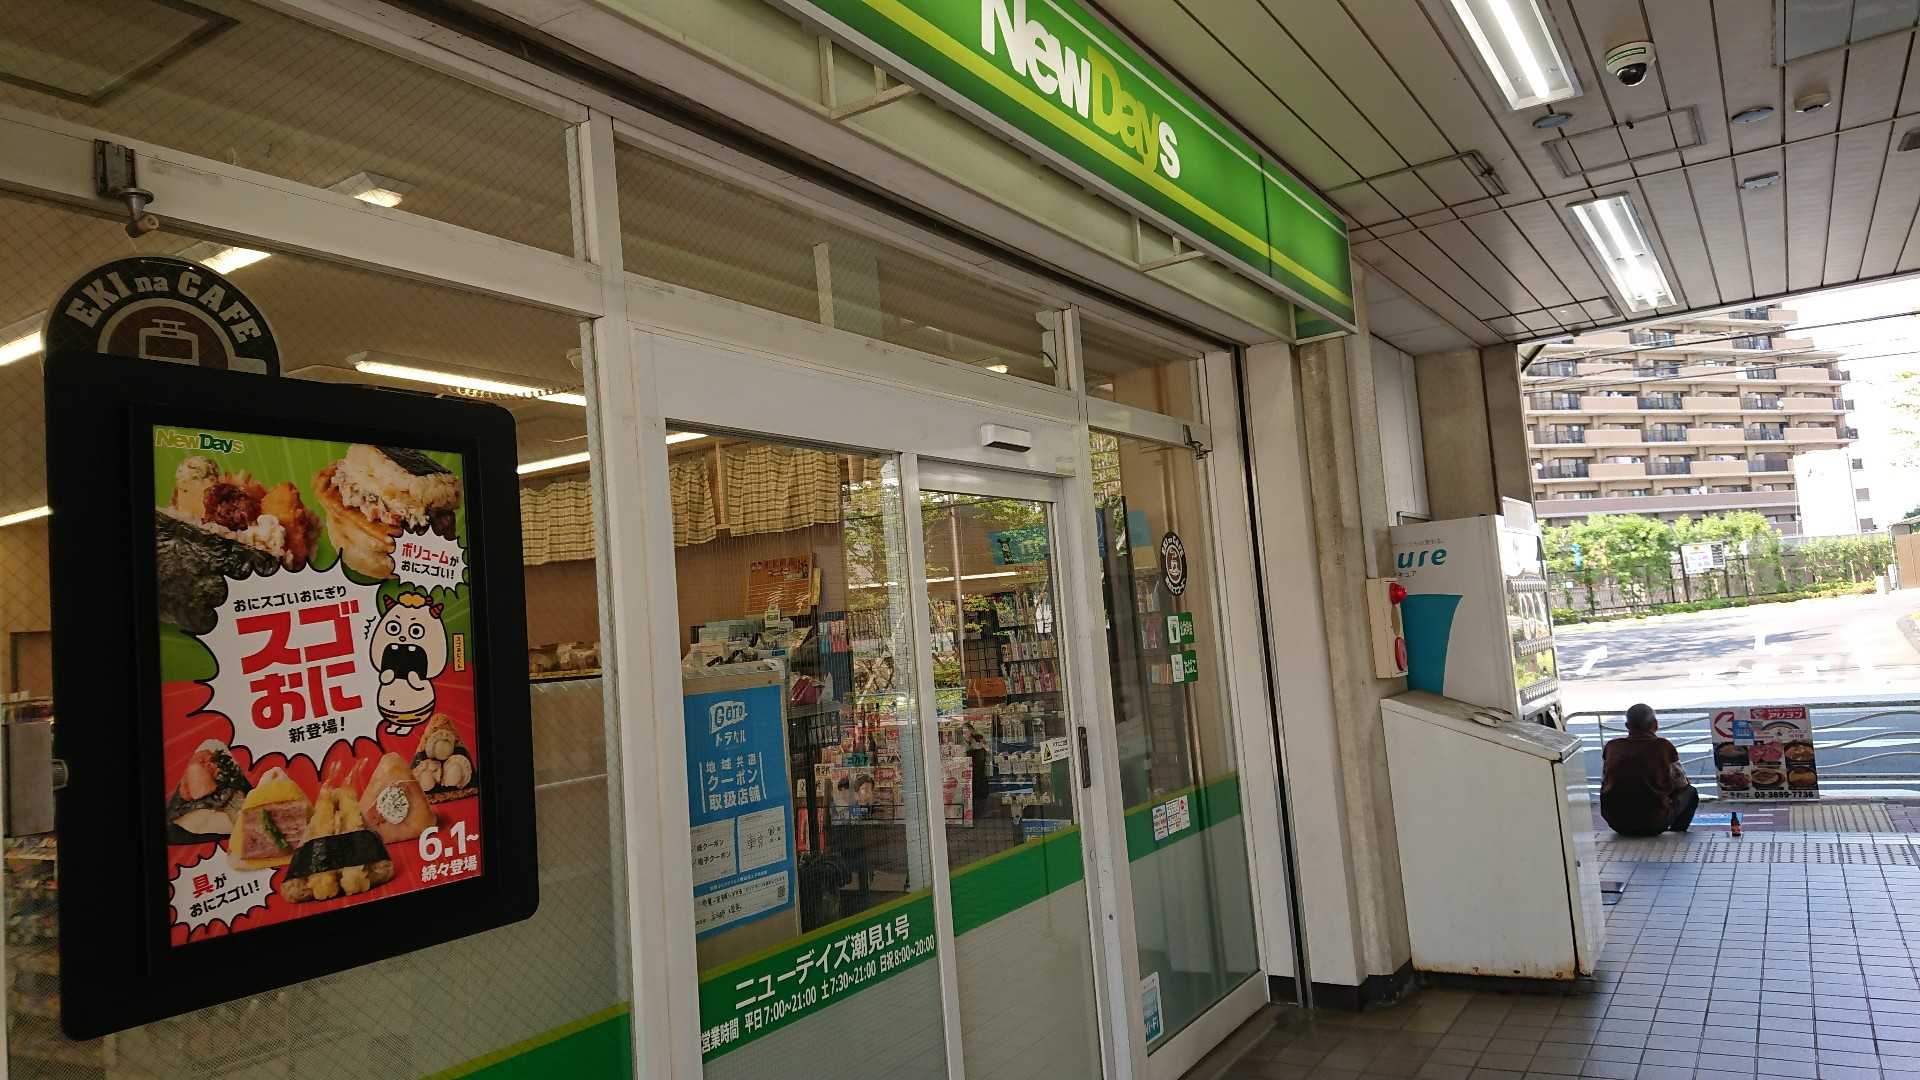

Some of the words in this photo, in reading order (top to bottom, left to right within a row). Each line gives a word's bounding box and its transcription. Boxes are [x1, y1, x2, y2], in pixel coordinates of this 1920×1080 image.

[981, 0, 1180, 179] NewDays
[66, 271, 131, 328] EKI
[134, 275, 169, 292] na
[177, 271, 262, 343] CAFE
[155, 428, 244, 454] NewDays
[402, 542, 459, 567] ボリュームが
[233, 585, 347, 613] おにスゴいおにぎり
[235, 599, 360, 675] スゴ
[250, 660, 363, 730] おに
[715, 730, 746, 747] トラベル
[708, 769, 758, 792] クーポン
[709, 785, 761, 812] 取扱店舗
[421, 855, 478, 882] 続々登場
[192, 872, 227, 897] 具が
[735, 914, 910, 1010] ニューデイズ潮見1号
[701, 1017, 739, 1054] 営業時間
